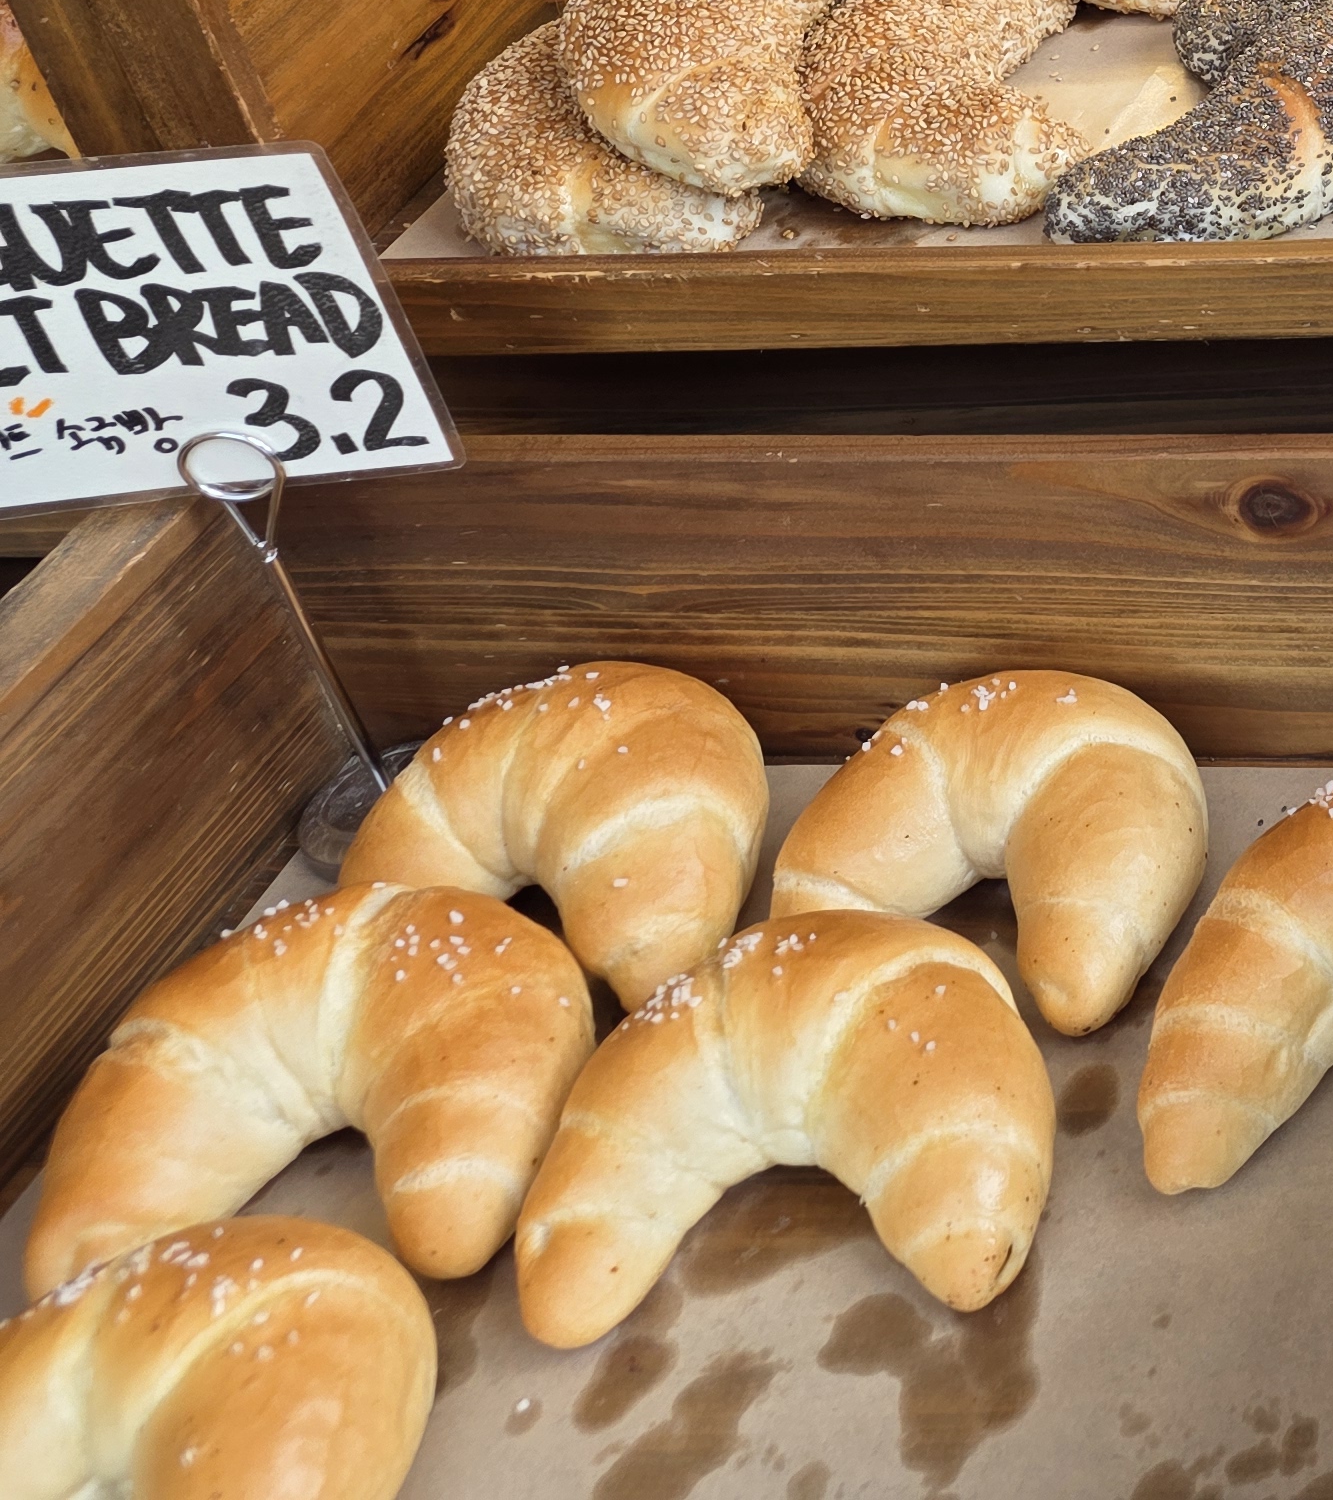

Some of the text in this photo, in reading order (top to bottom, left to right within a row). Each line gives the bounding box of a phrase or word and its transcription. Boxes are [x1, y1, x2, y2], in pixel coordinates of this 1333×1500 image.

[0, 184, 323, 292] UETTE
[0, 271, 384, 388] T BREAD
[56, 406, 184, 455] 소금빵
[226, 369, 430, 463] 3.2
